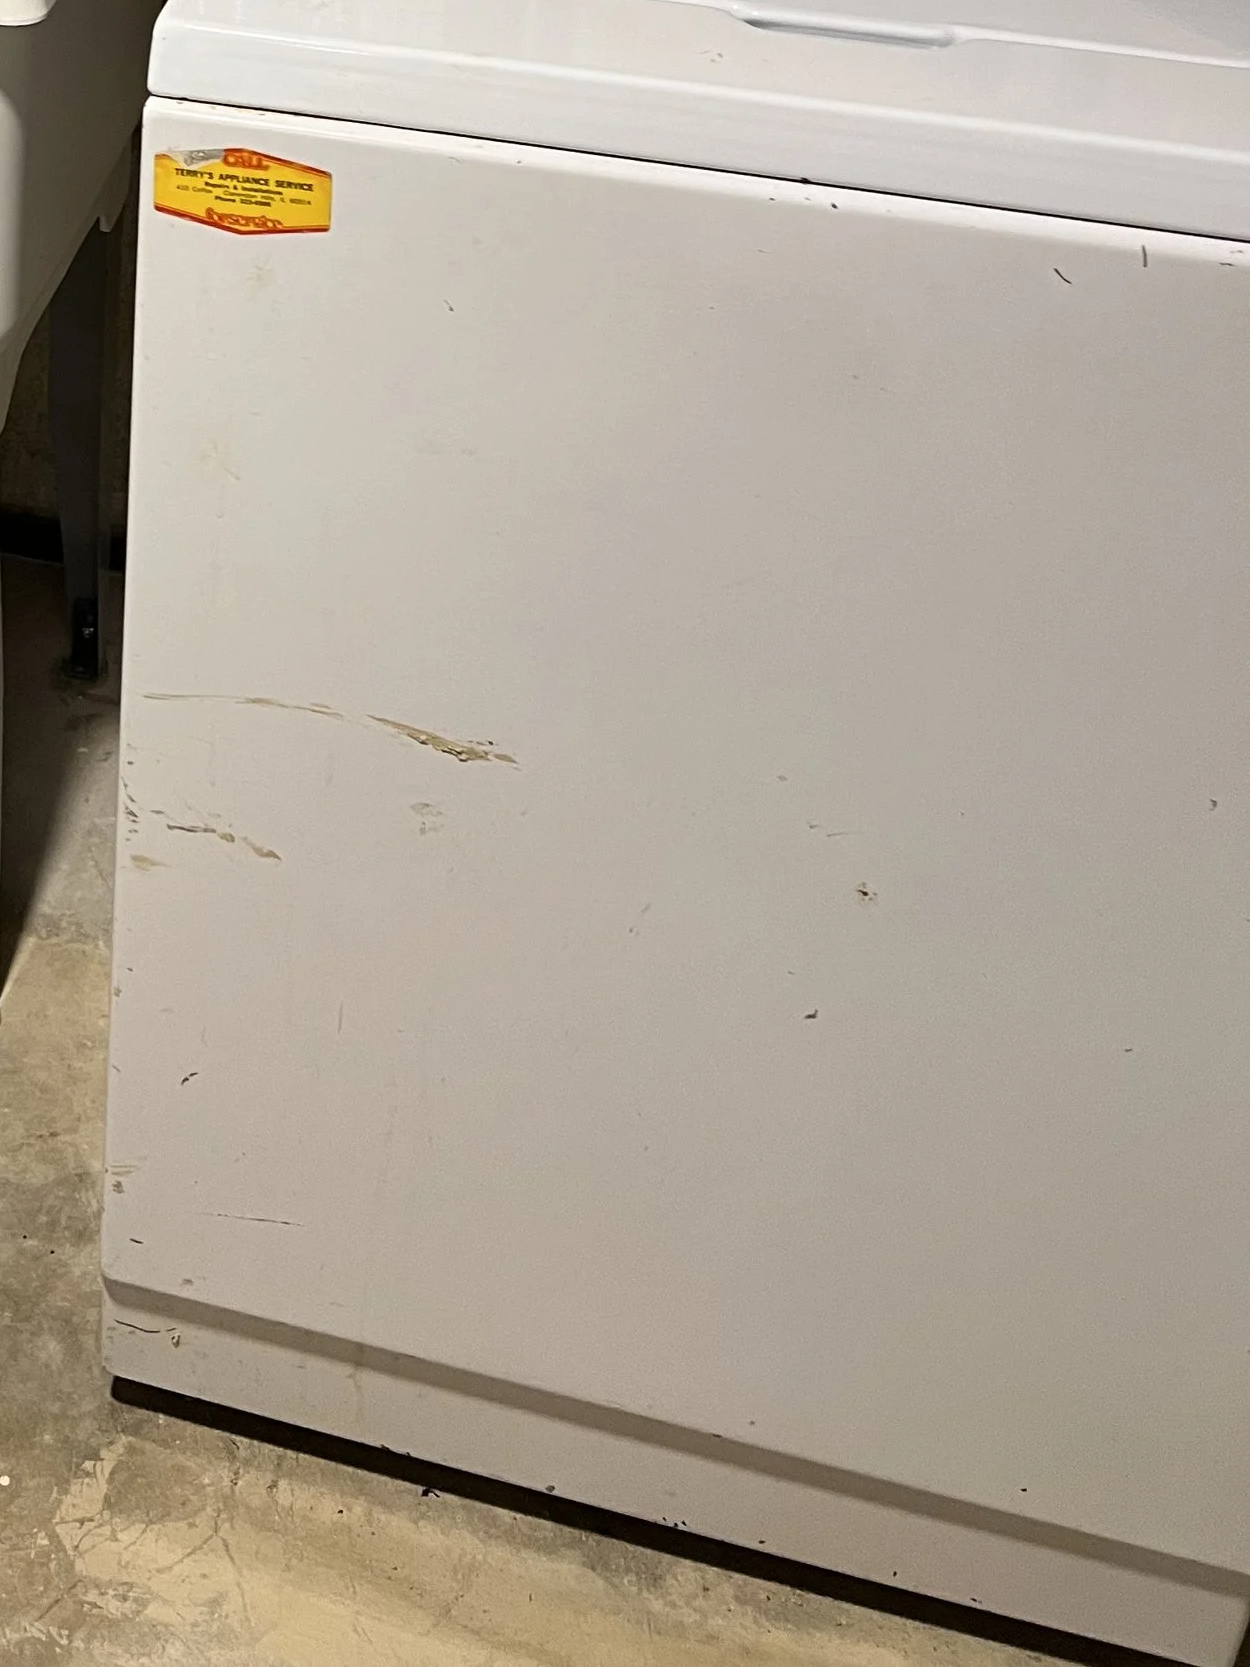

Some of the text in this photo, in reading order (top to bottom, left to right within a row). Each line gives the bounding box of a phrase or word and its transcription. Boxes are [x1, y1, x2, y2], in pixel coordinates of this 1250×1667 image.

[175, 168, 314, 192] TERRY'S APPLIANCE SERVICE
